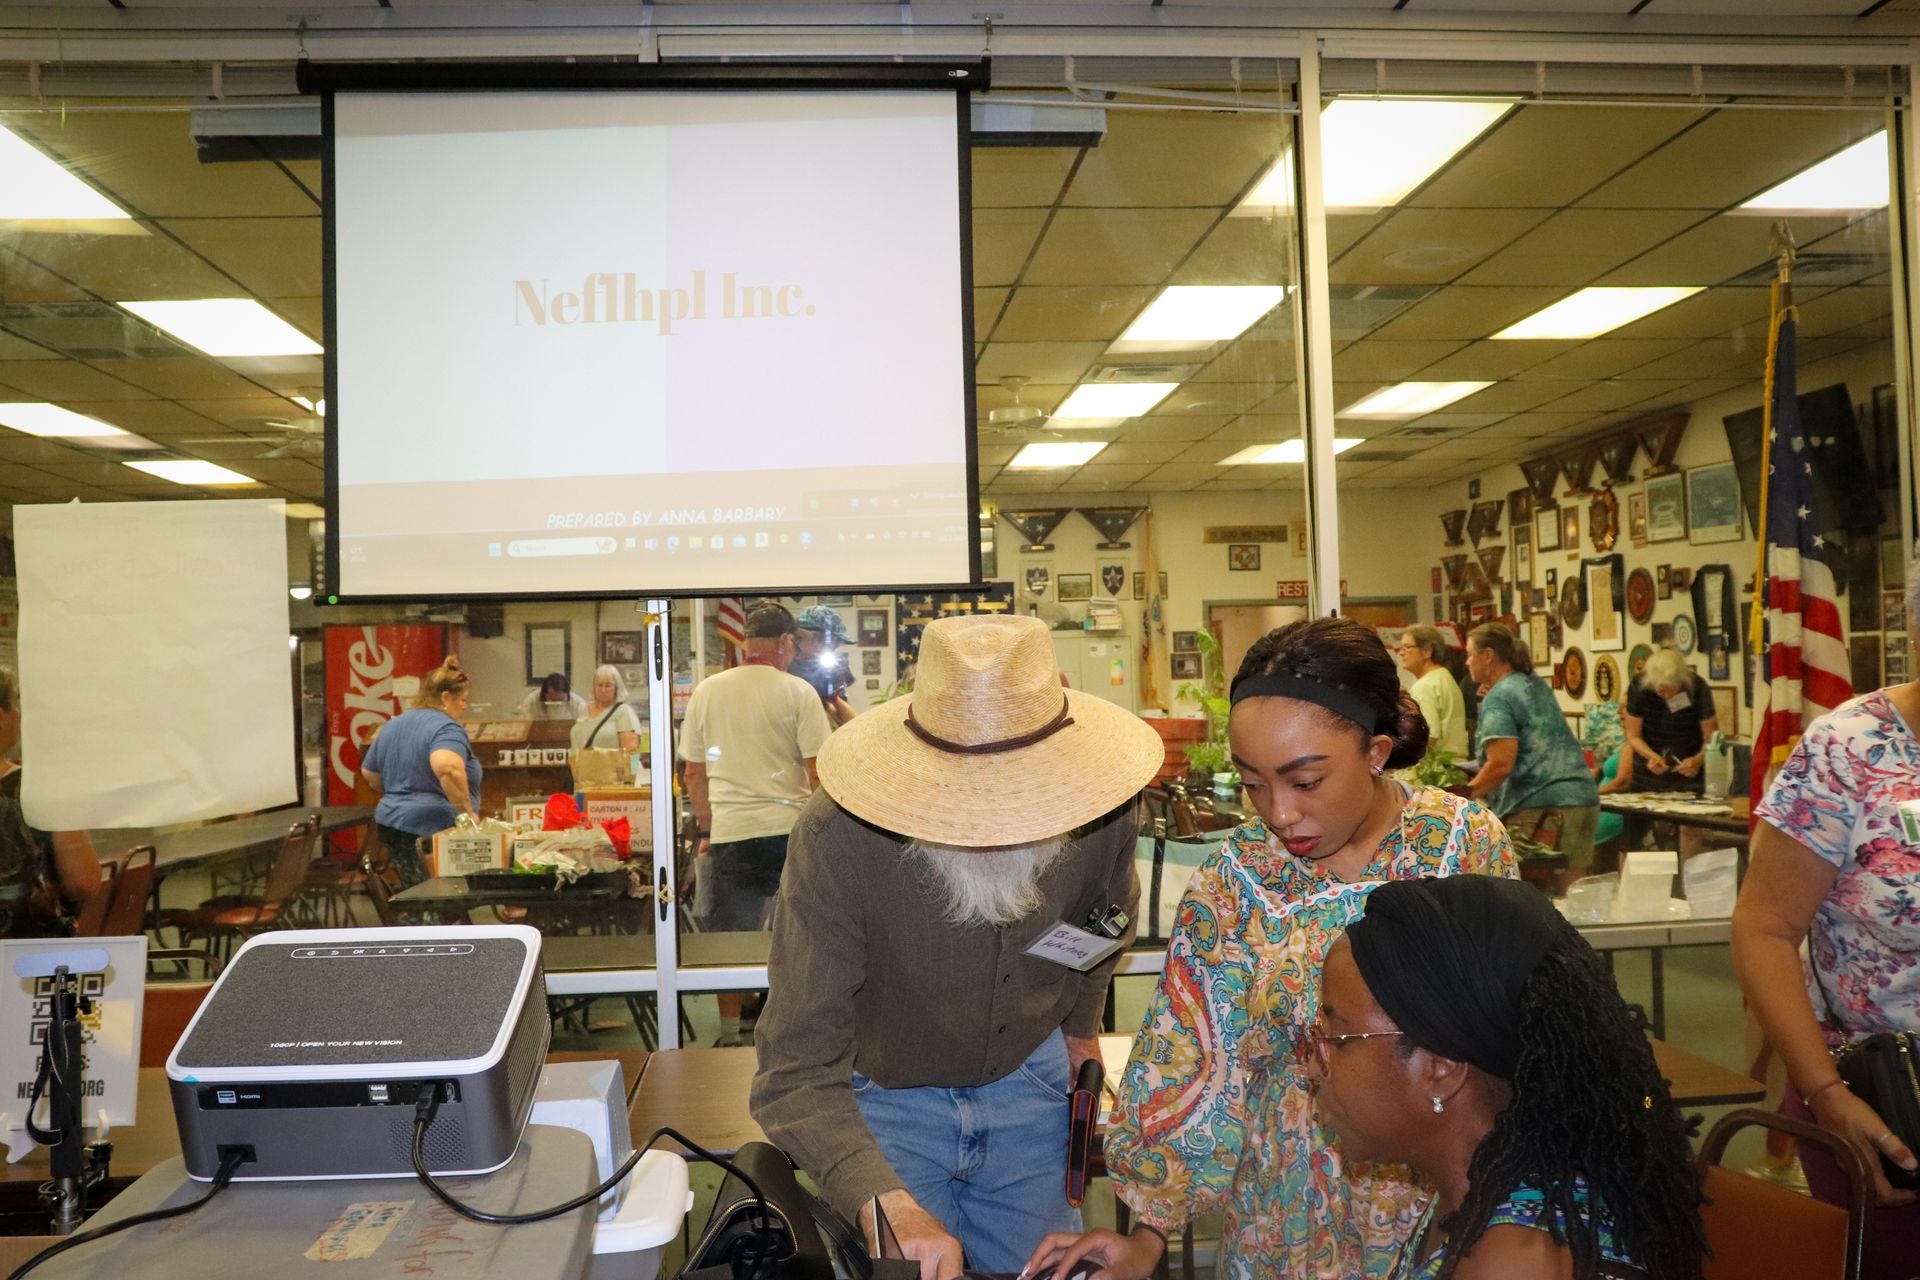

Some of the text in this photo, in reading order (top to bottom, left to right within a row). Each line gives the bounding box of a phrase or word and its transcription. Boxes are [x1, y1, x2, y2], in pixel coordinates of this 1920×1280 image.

[719, 272, 817, 319] Inc.
[546, 507, 785, 529] PREPARED BY ANNA BARBARY
[1053, 930, 1083, 944] Bill
